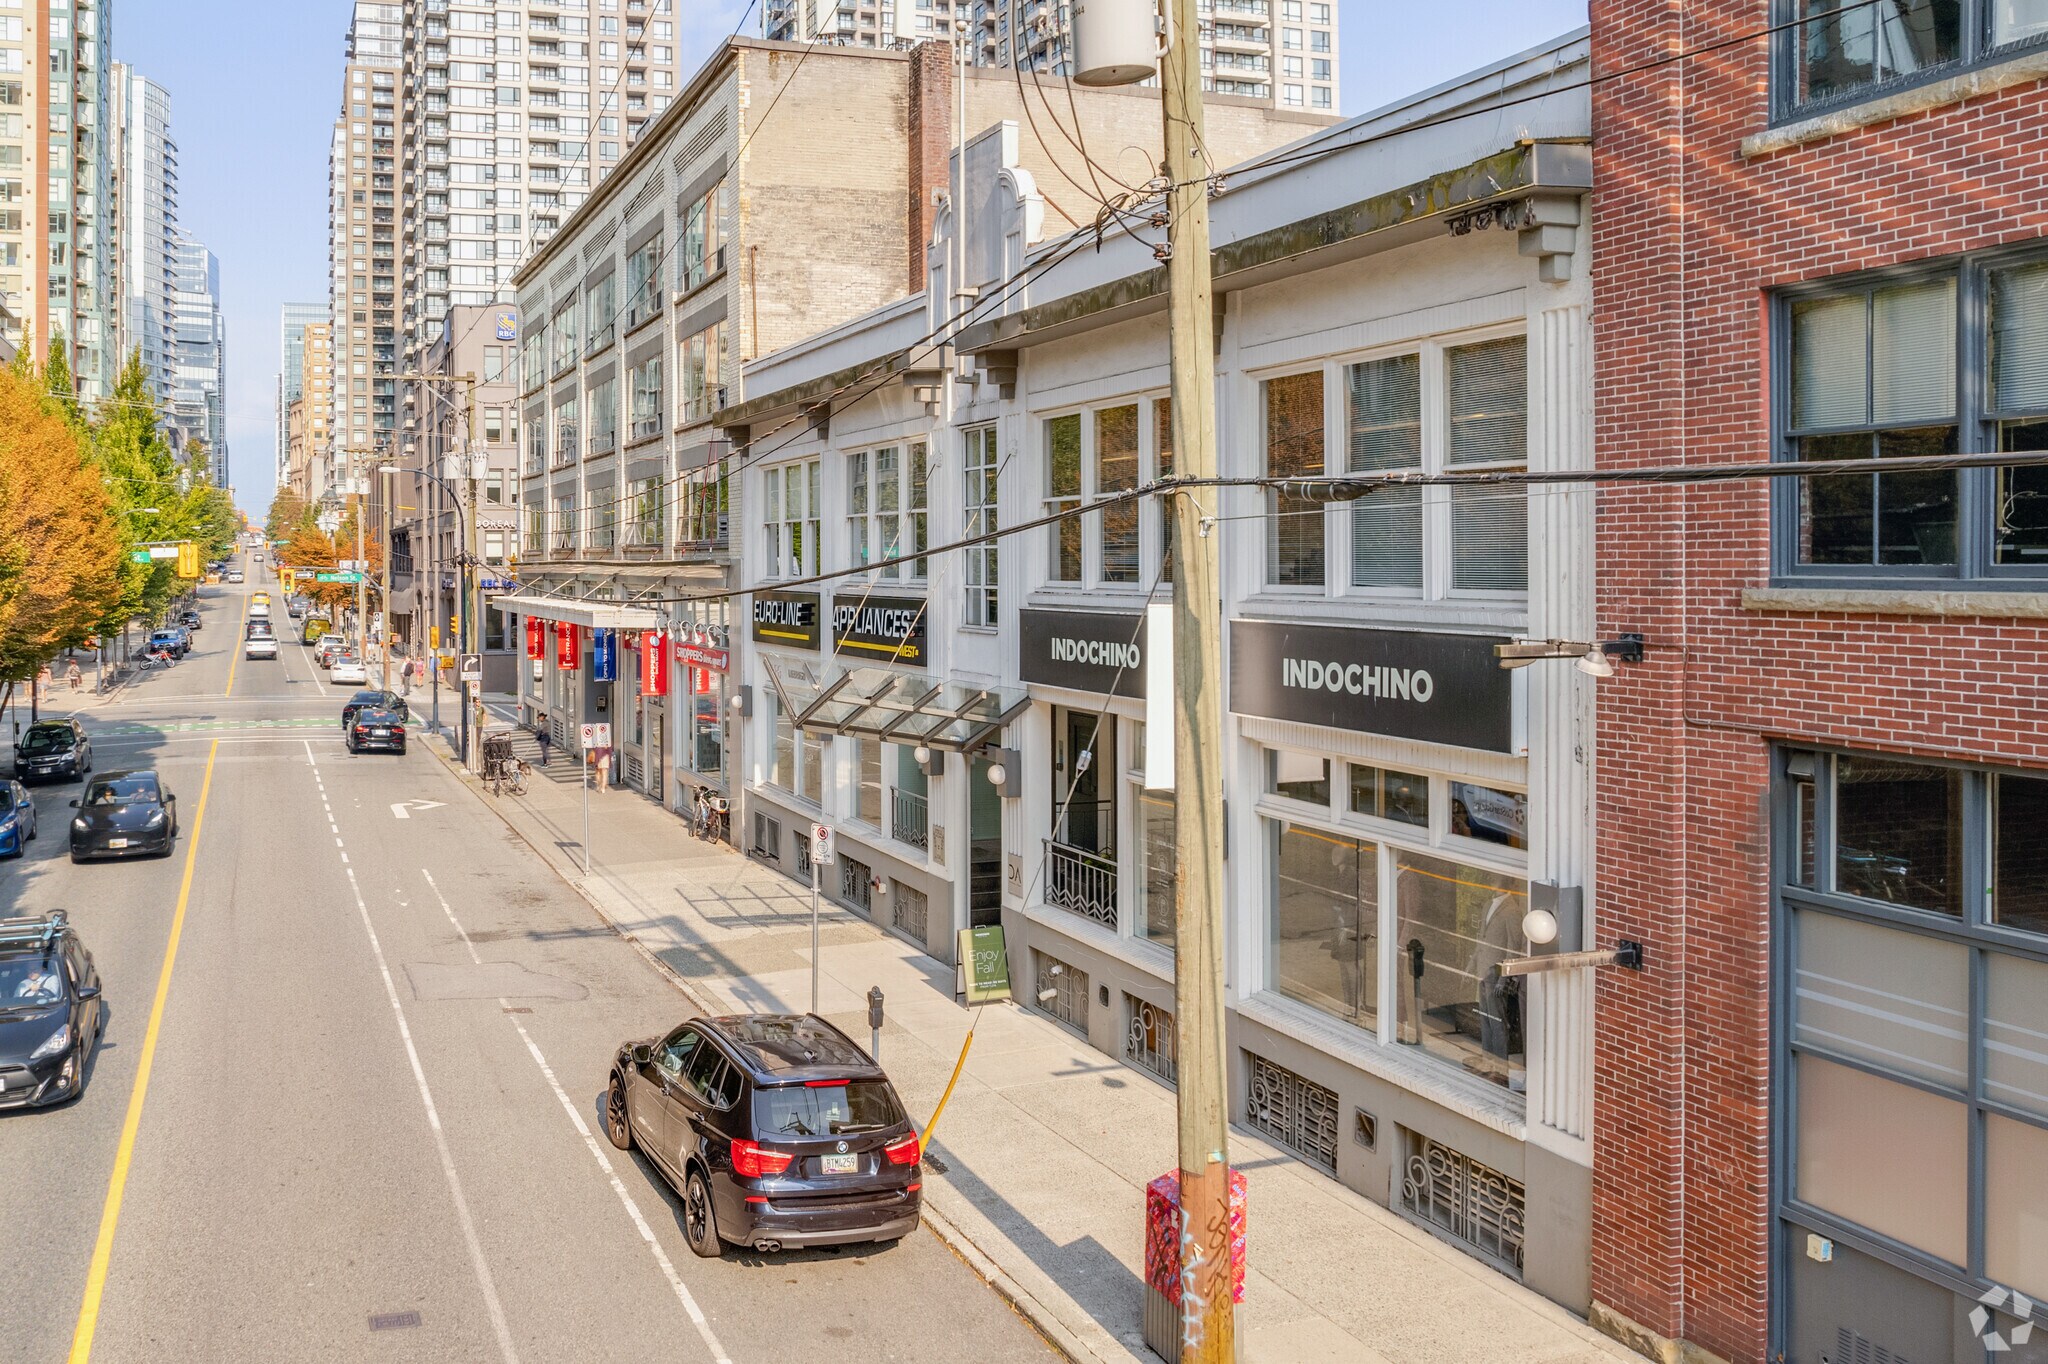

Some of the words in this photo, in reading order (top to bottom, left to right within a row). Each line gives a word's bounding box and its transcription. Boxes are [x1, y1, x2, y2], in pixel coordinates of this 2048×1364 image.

[832, 606, 911, 638] APPLIANCES
[603, 655, 608, 663] TO
[677, 647, 703, 662] SHOPPERS
[1051, 638, 1140, 669] INDOCHINO
[1283, 658, 1433, 703] INDOCHINO
[968, 948, 999, 962] Enjoy
[976, 961, 994, 974] Fall
[826, 1157, 855, 1169] BTM4259
